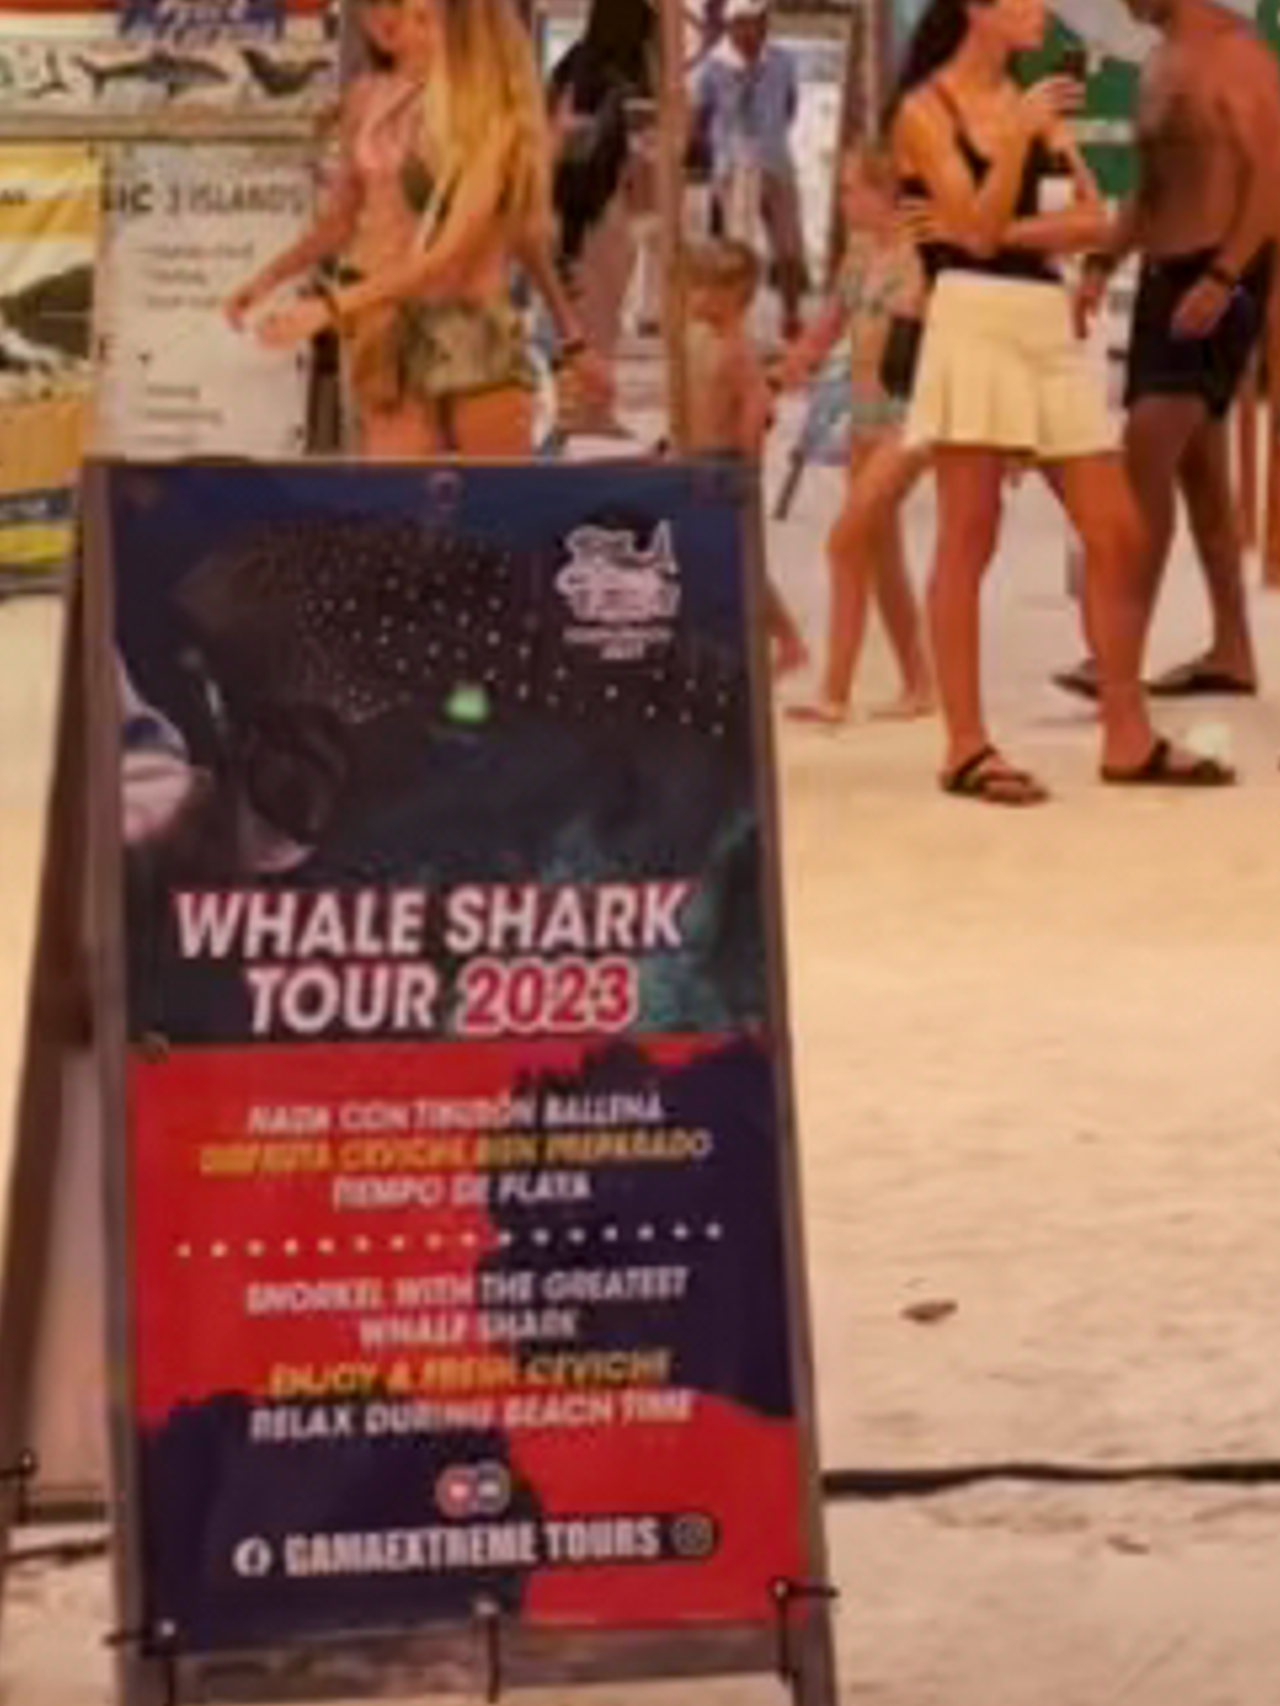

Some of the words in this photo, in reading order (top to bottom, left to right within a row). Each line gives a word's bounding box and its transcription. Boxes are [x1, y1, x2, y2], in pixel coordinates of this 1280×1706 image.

[173, 887, 427, 960] WHALE
[444, 880, 690, 953] SHARK
[247, 965, 438, 1033] TOUR
[456, 957, 640, 1035] 2023
[338, 1099, 410, 1131] CON
[544, 1091, 664, 1125] BALLENA
[200, 1142, 330, 1174] DISFRUTA
[339, 1138, 467, 1170] CEVICHE
[476, 1133, 538, 1165] BIEN
[545, 1127, 714, 1162] PREPARADO
[332, 1175, 445, 1212] TIEMPO
[452, 1174, 488, 1206] DE
[496, 1171, 592, 1203] PLAYA
[246, 1279, 382, 1316] SNORKEL
[395, 1275, 474, 1308] WITH
[480, 1271, 536, 1302] THE
[542, 1266, 691, 1300] GREATEST
[359, 1315, 468, 1351] WHALE
[477, 1308, 579, 1342] SHARK
[268, 1363, 377, 1399] ENJOY
[422, 1356, 516, 1389] FRESH
[526, 1348, 671, 1384] CEVICHE
[249, 1405, 353, 1441] RELAX
[364, 1398, 492, 1435] DURING
[503, 1392, 612, 1427] BEACH
[621, 1388, 696, 1425] TIME
[283, 1524, 537, 1576] GAMAEXTREME
[547, 1516, 661, 1562] TOURS
